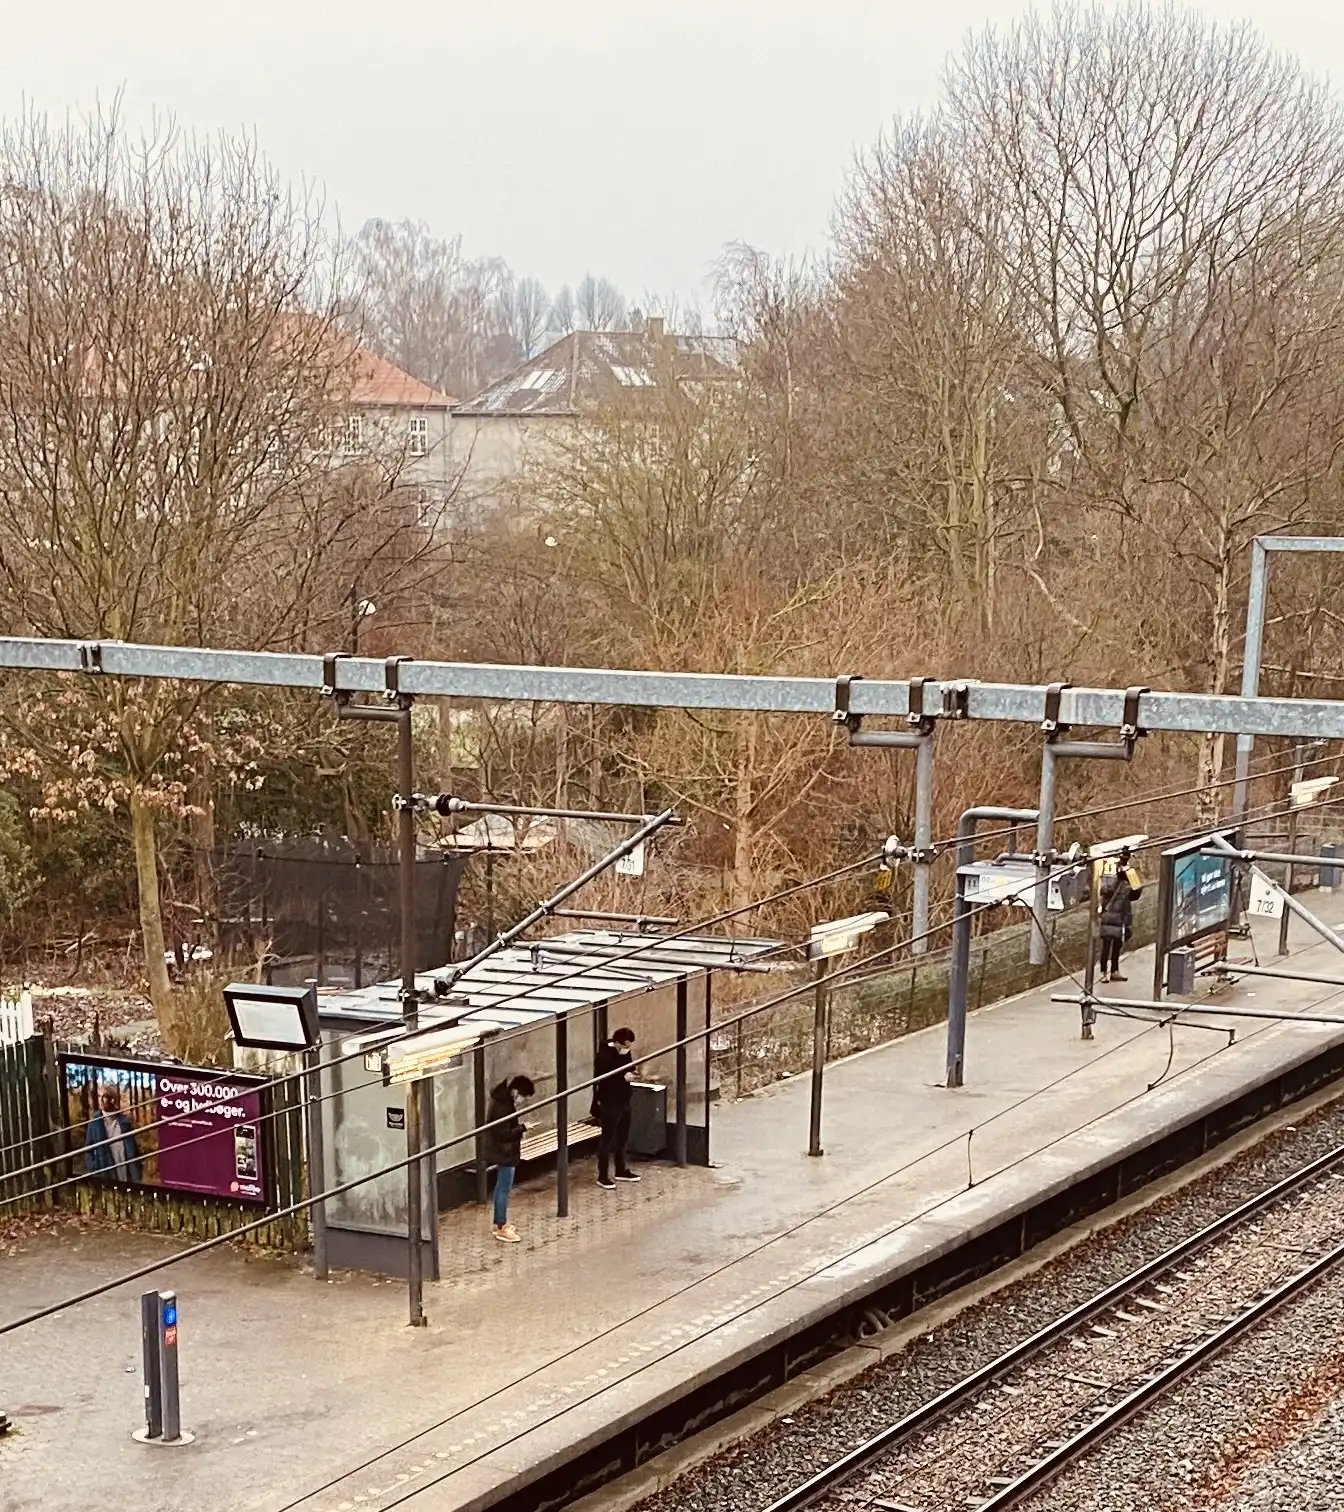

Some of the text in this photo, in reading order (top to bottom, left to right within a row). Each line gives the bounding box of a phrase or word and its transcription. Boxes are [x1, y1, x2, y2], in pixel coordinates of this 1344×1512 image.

[1257, 899, 1274, 914] 7/32
[159, 1078, 239, 1099] Over 300.000
[160, 1097, 173, 1107] e-
[175, 1099, 191, 1113] og
